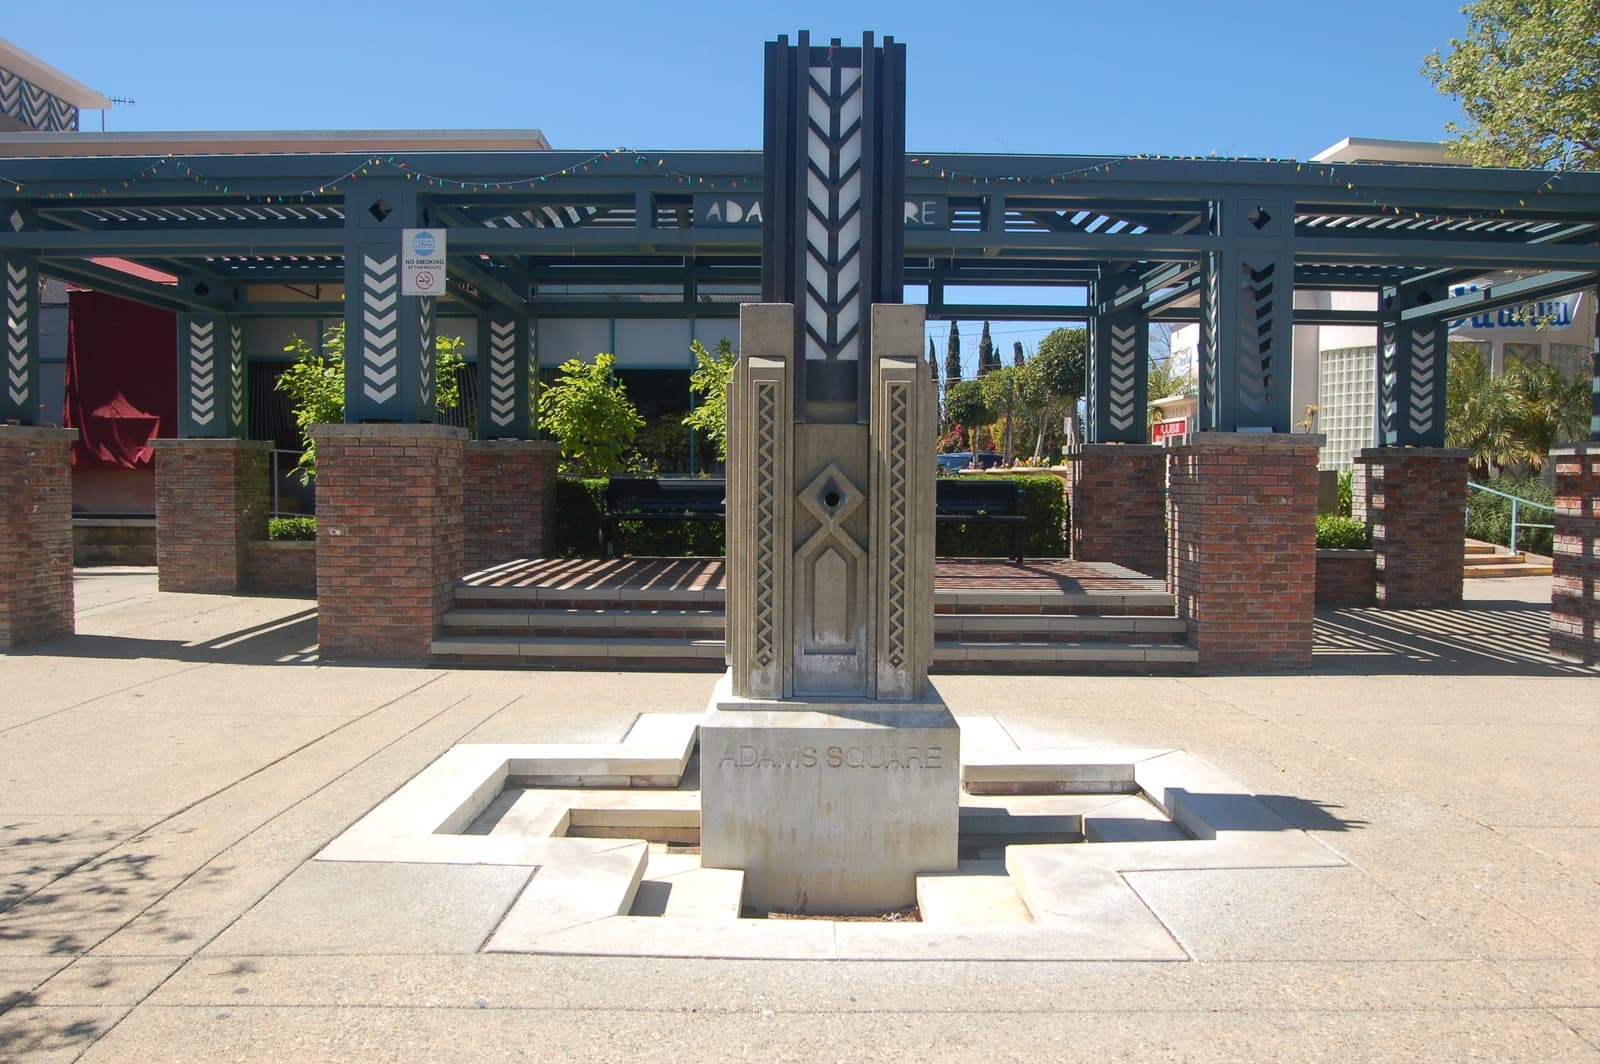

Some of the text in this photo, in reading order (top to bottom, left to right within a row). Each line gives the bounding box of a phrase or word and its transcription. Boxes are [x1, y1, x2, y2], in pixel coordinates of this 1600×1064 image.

[706, 200, 763, 223] ADA
[718, 744, 943, 769] ADAMS SQUARE
